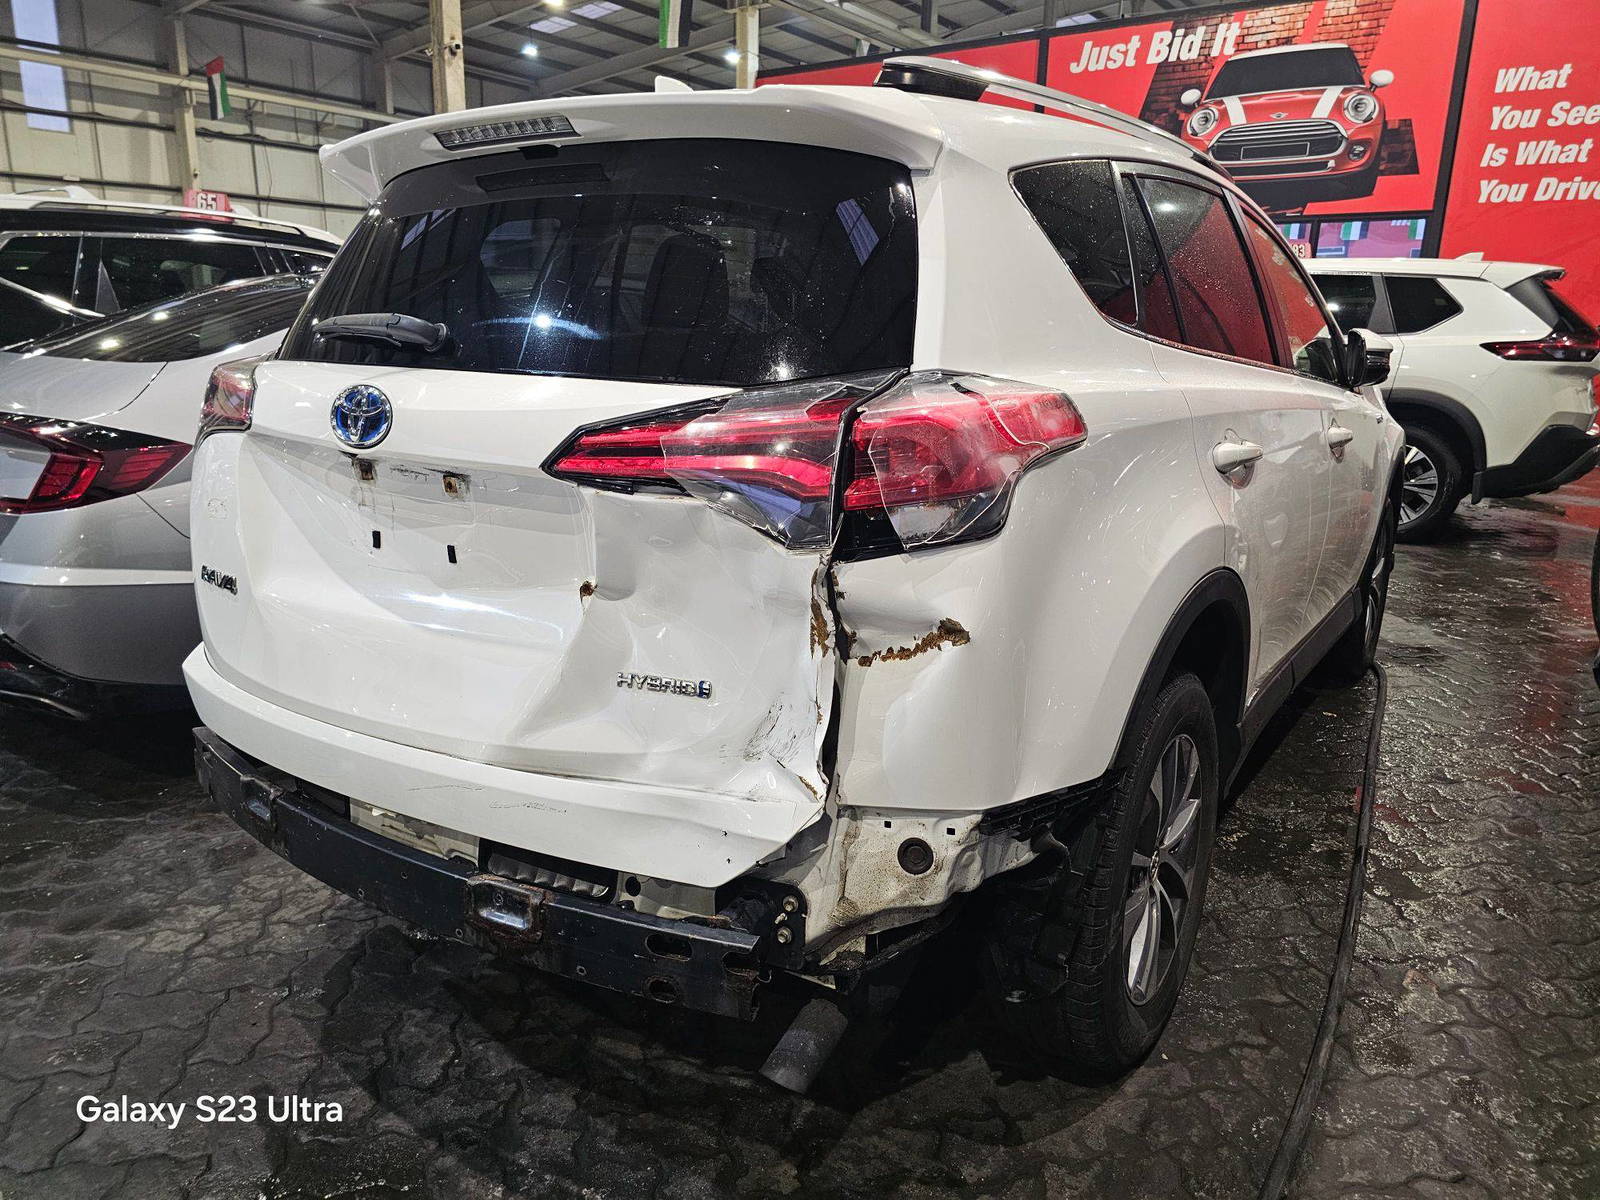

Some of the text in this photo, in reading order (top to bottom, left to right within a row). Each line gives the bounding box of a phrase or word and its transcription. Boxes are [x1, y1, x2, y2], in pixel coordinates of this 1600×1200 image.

[1069, 22, 1242, 74] Just Bid It
[1494, 63, 1573, 94] What
[1490, 101, 1600, 130] You See
[1480, 138, 1594, 168] Is What
[197, 192, 217, 211] 65
[1478, 179, 1529, 204] You
[616, 671, 697, 697] HYBRID
